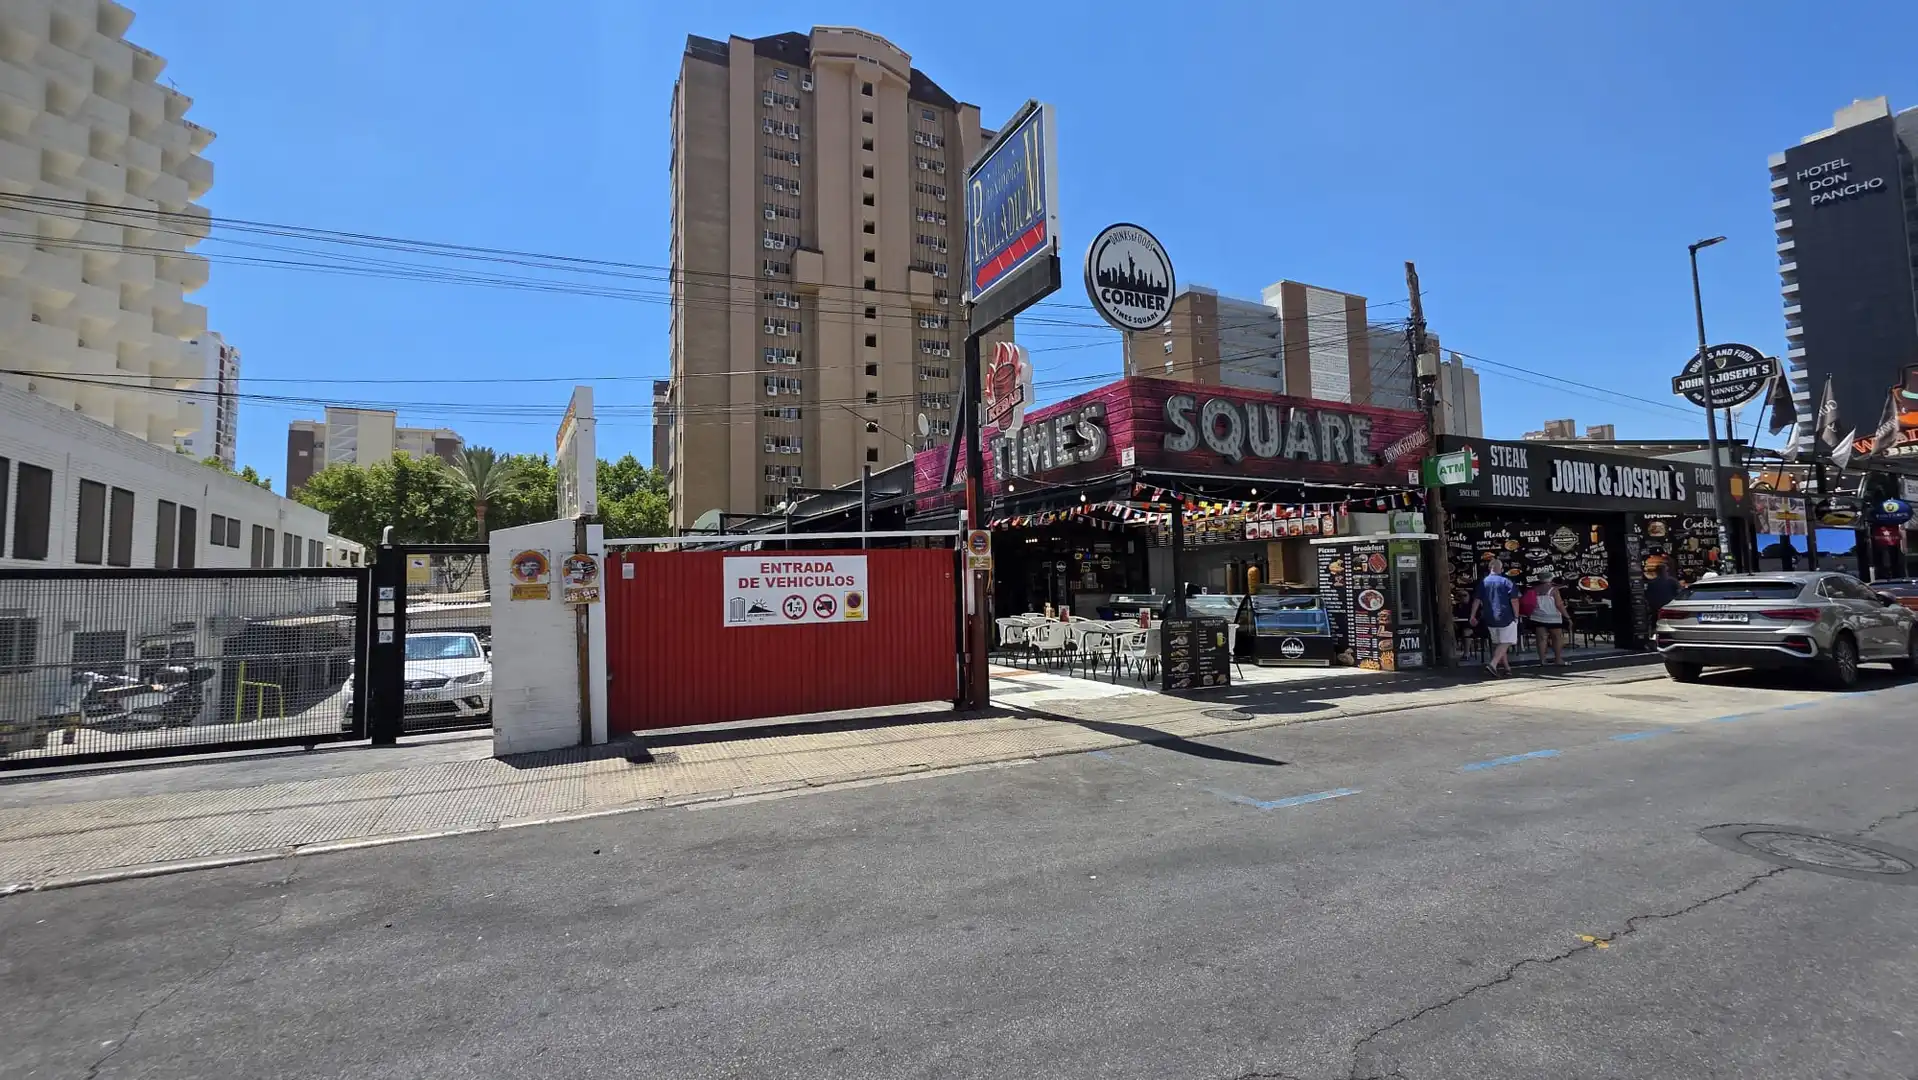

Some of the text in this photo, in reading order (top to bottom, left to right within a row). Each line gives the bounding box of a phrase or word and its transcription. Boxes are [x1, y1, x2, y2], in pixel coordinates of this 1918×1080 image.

[1796, 158, 1852, 181] HOTEL
[1809, 172, 1848, 191] DON
[1810, 177, 1884, 206] PANCHO
[1101, 288, 1166, 312] CORNER
[1113, 306, 1159, 325] TIMES SQUARE
[1716, 348, 1734, 357] AND
[1733, 349, 1754, 362] FOOD
[1679, 377, 1705, 390] JOHN
[1711, 384, 1745, 396] UINNESS
[989, 394, 1376, 482] TIMES SQUARE
[1490, 444, 1528, 469] STEAK
[1440, 463, 1464, 475] ATM
[1552, 459, 1597, 495] JOHN
[1598, 463, 1612, 496] &
[1492, 474, 1530, 498] HOUSE
[760, 562, 835, 574] ENTRADA
[738, 575, 855, 588] DE VEHICULOS
[1399, 637, 1420, 650] ATM
